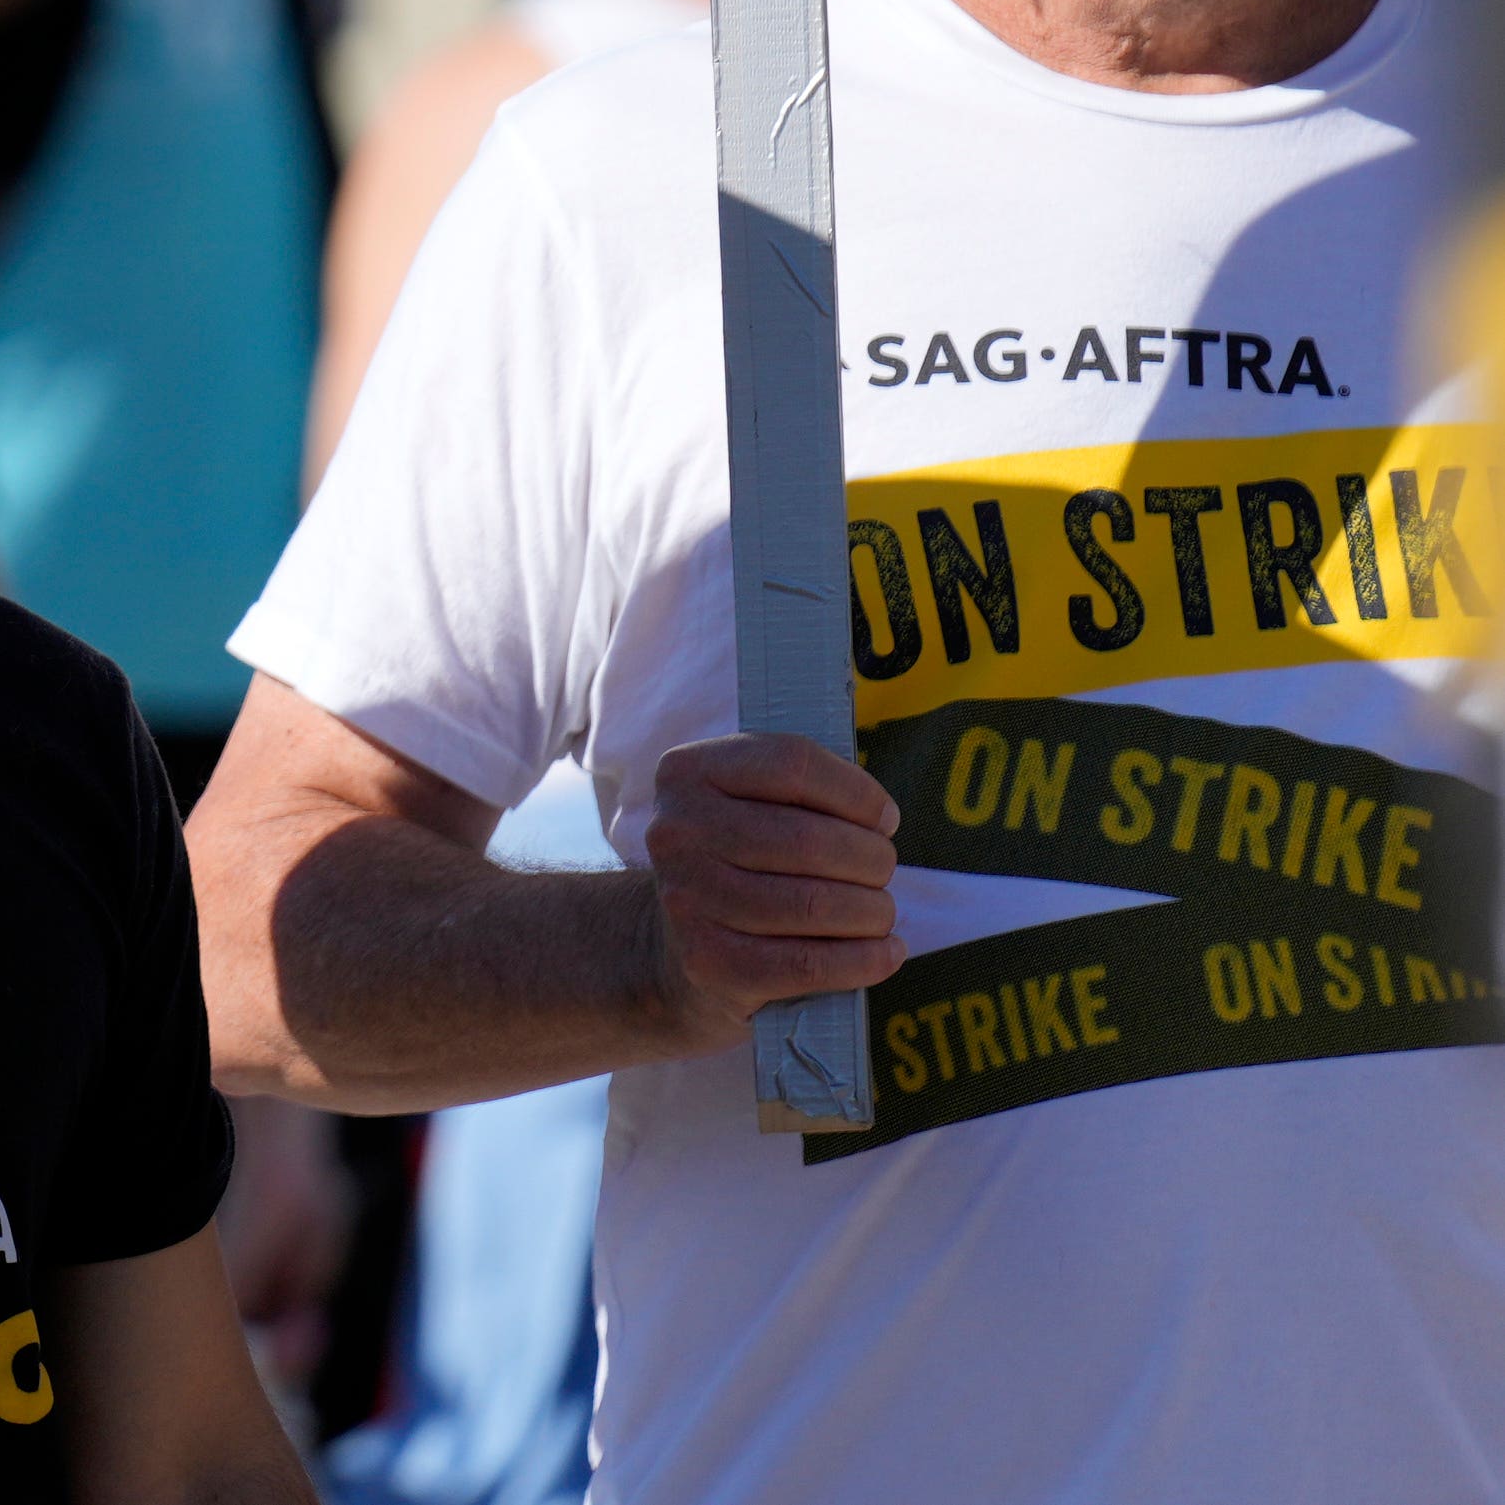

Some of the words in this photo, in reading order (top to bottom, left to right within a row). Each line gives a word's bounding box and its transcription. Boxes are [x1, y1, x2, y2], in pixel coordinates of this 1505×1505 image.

[849, 498, 1021, 682] ON
[1062, 467, 1505, 653] STRIK
[944, 725, 1075, 835] ON
[1099, 749, 1433, 910] STRIKE
[886, 964, 1120, 1095] STRIKE
[1204, 937, 1302, 1024] ON
